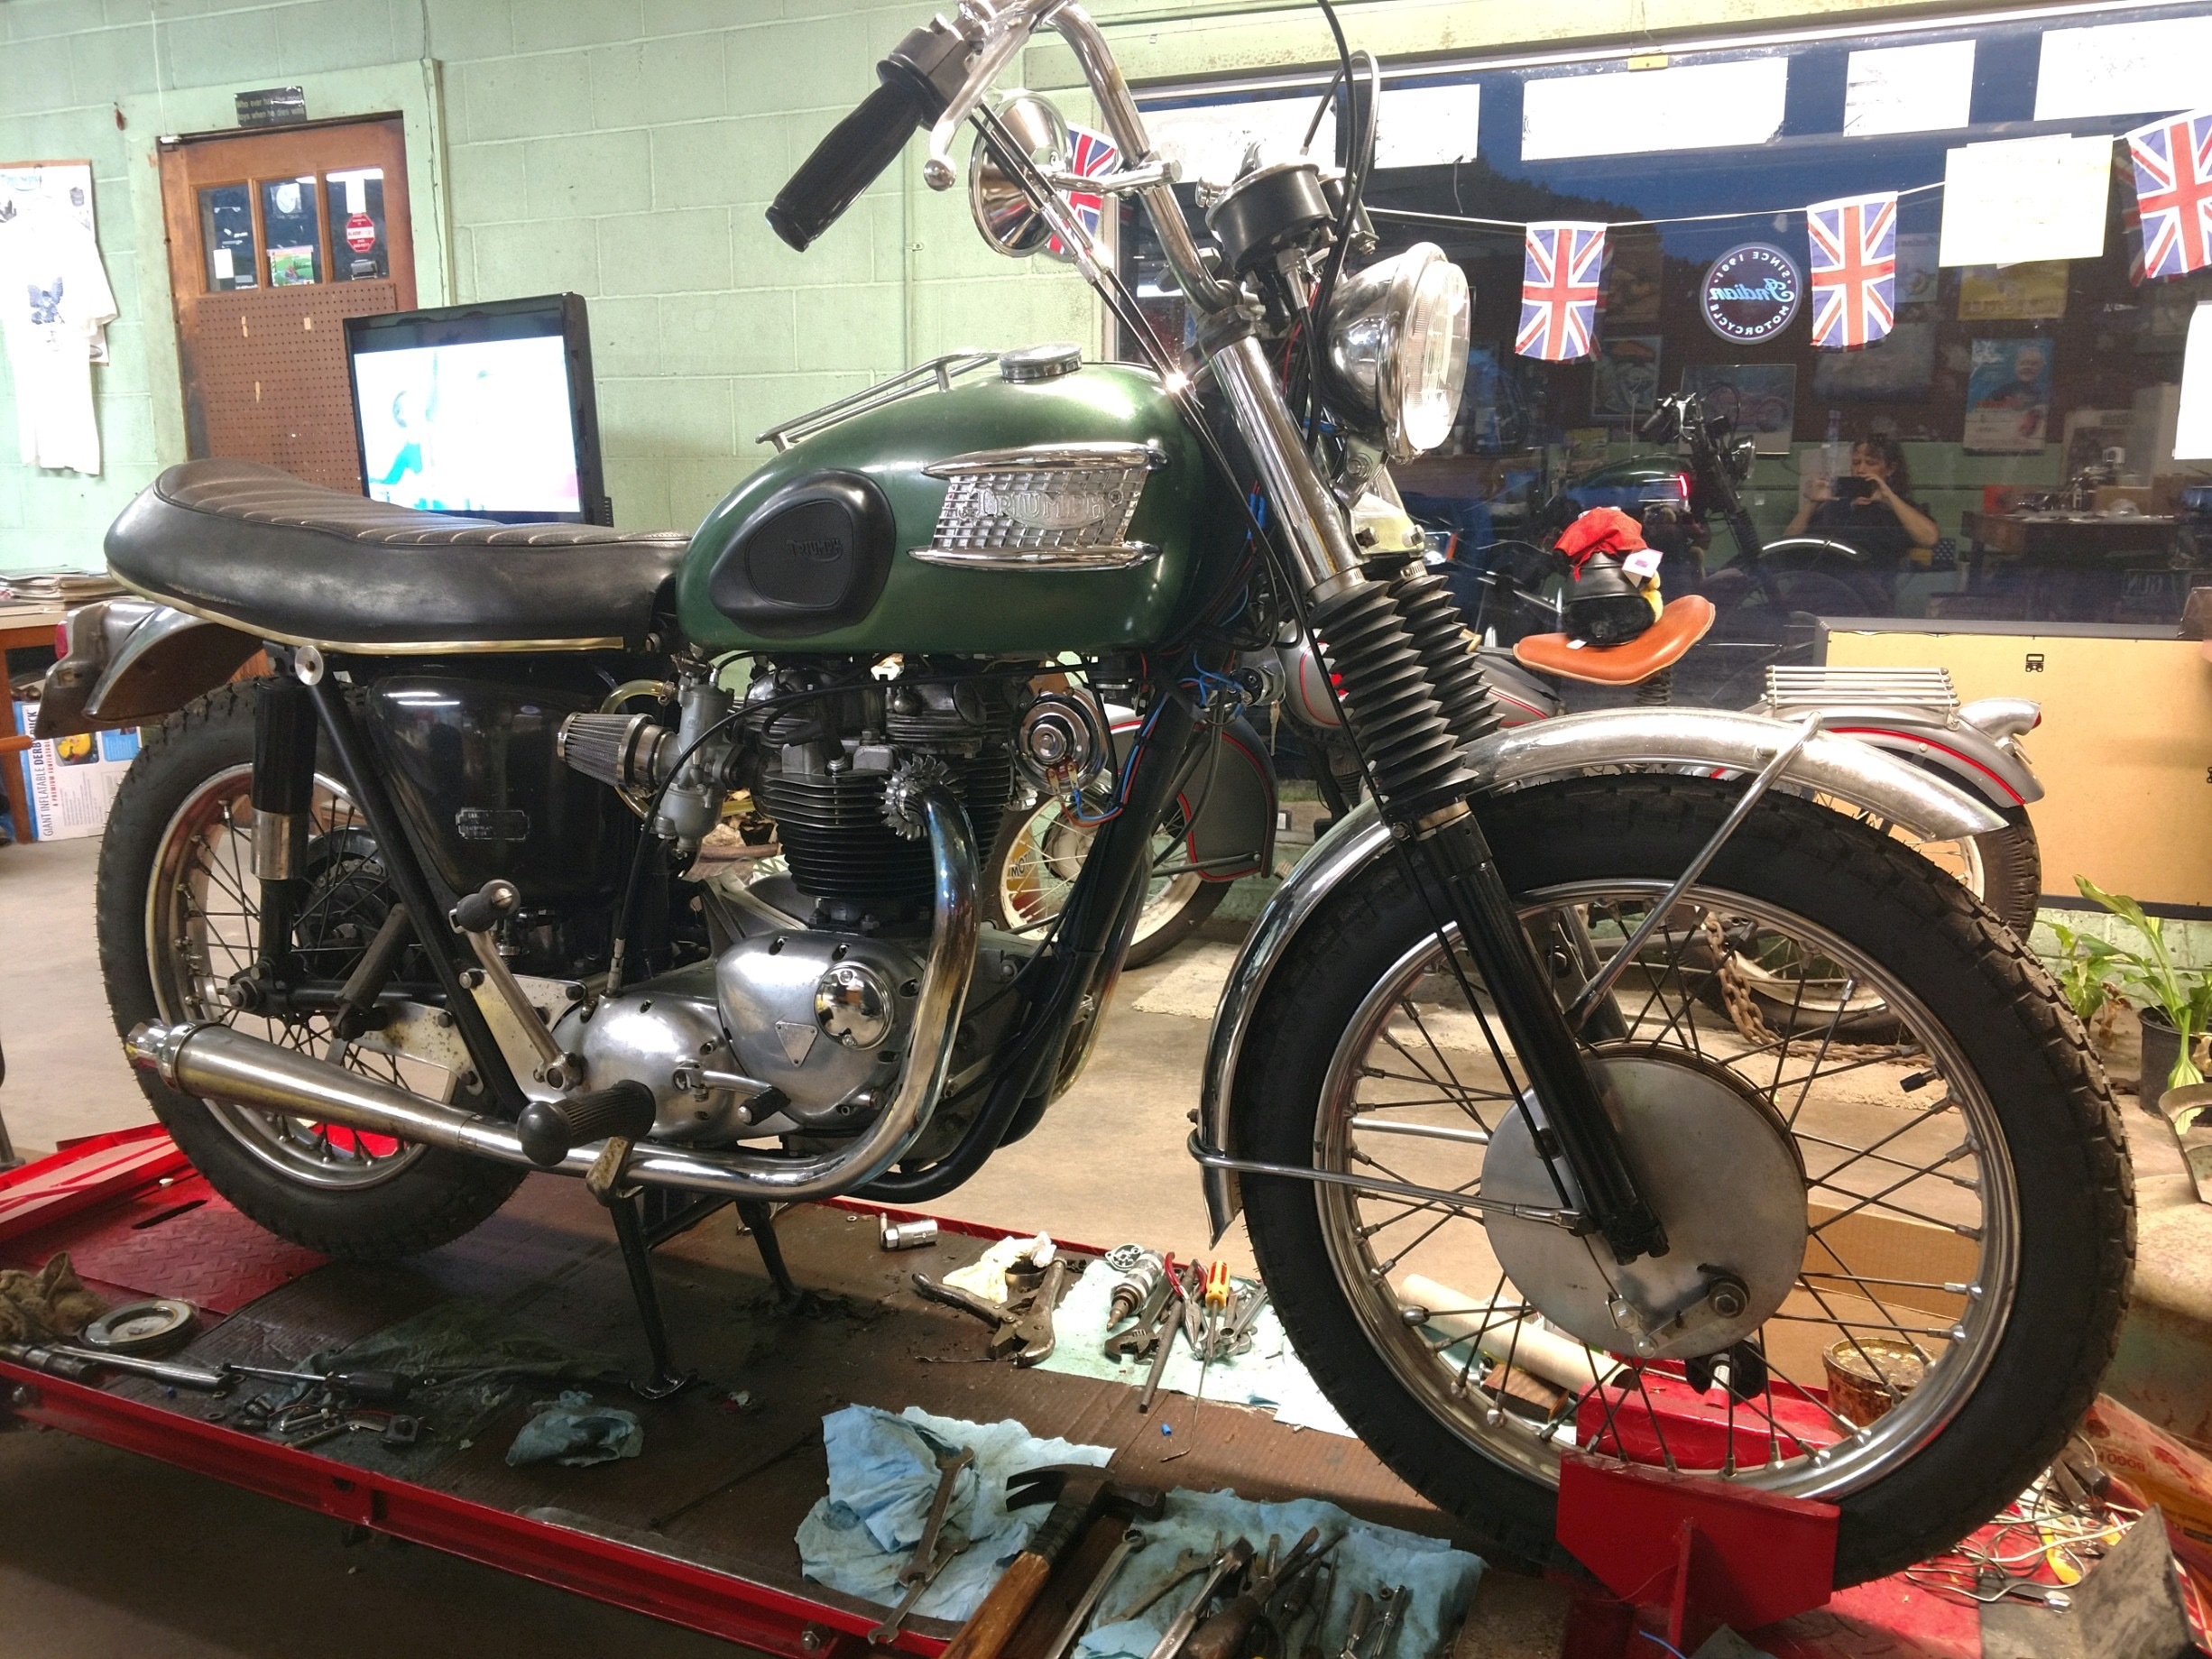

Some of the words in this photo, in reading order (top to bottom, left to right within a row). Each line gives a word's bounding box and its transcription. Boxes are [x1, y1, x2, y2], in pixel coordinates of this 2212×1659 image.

[969, 487, 1107, 520] TRIUMPH
[787, 539, 843, 559] TRIUMPH
[44, 741, 54, 774] FUNFLATABL
[34, 767, 49, 812] INFLATABLE
[49, 776, 58, 802] PREMIUM
[41, 814, 54, 836] GIANT
[2106, 1453, 2146, 1472] BOGO
